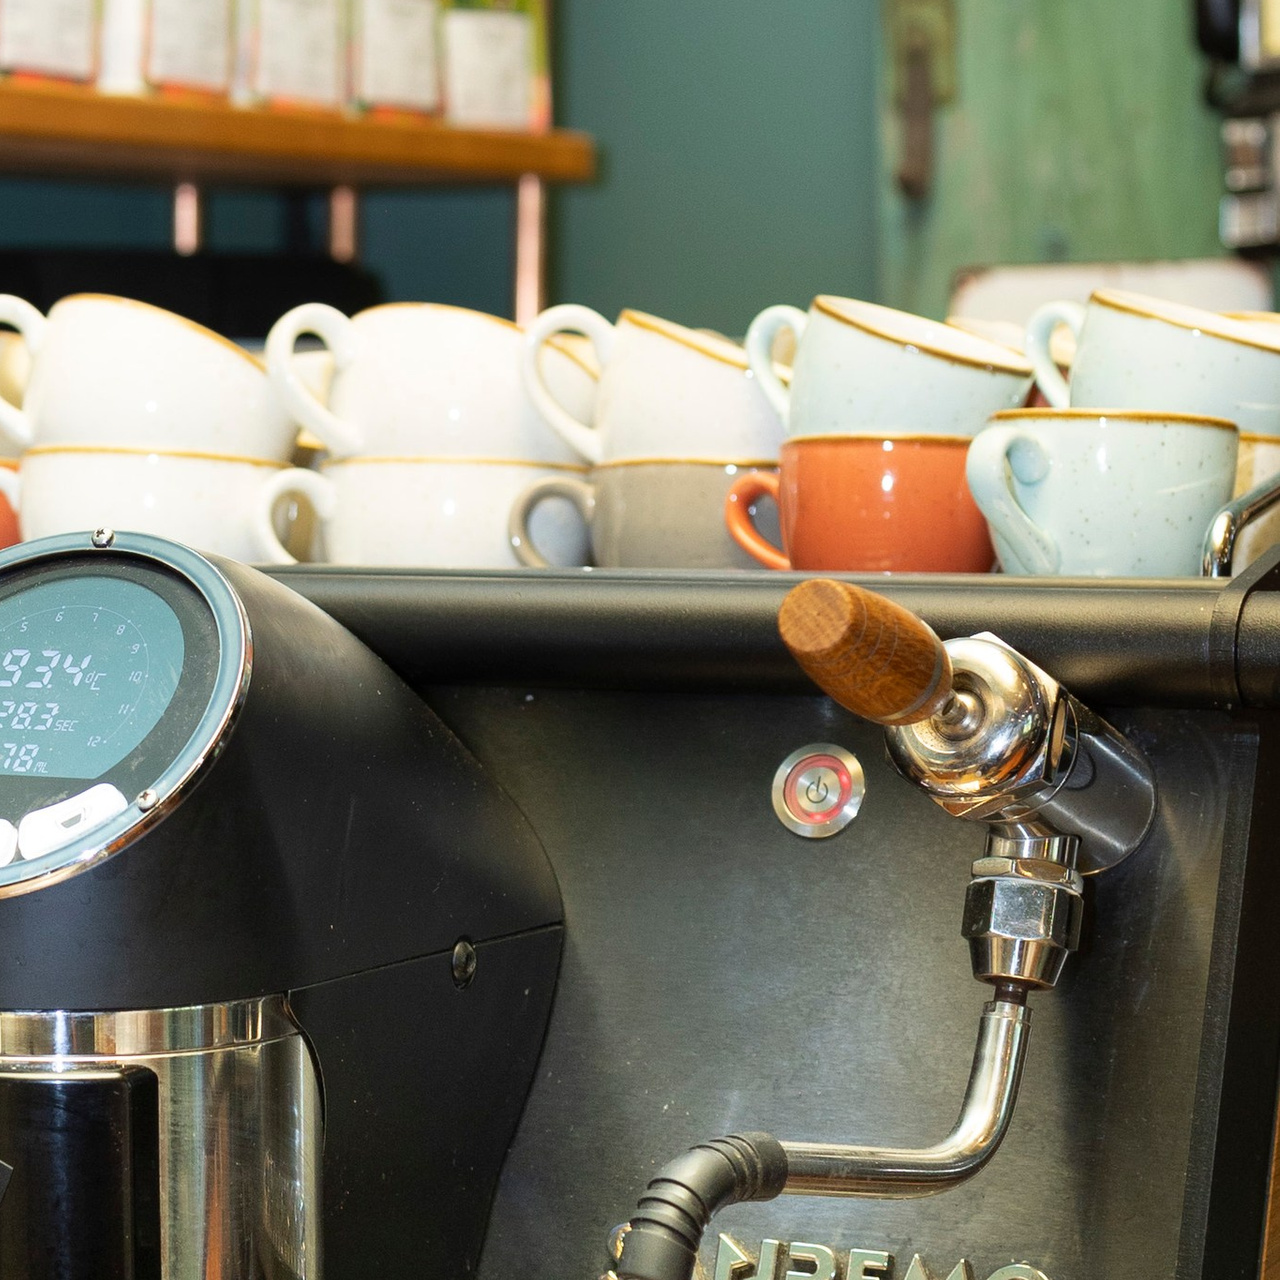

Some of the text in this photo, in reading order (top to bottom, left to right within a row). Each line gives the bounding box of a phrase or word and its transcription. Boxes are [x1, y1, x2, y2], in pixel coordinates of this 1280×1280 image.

[55, 611, 63, 622] 6
[92, 613, 99, 622] 7
[20, 622, 28, 632] 5
[116, 624, 126, 635] 8
[131, 643, 140, 654] 9
[128, 671, 142, 682] 10
[118, 704, 129, 715] 11
[53, 720, 79, 732] SEC
[87, 736, 101, 747] 12
